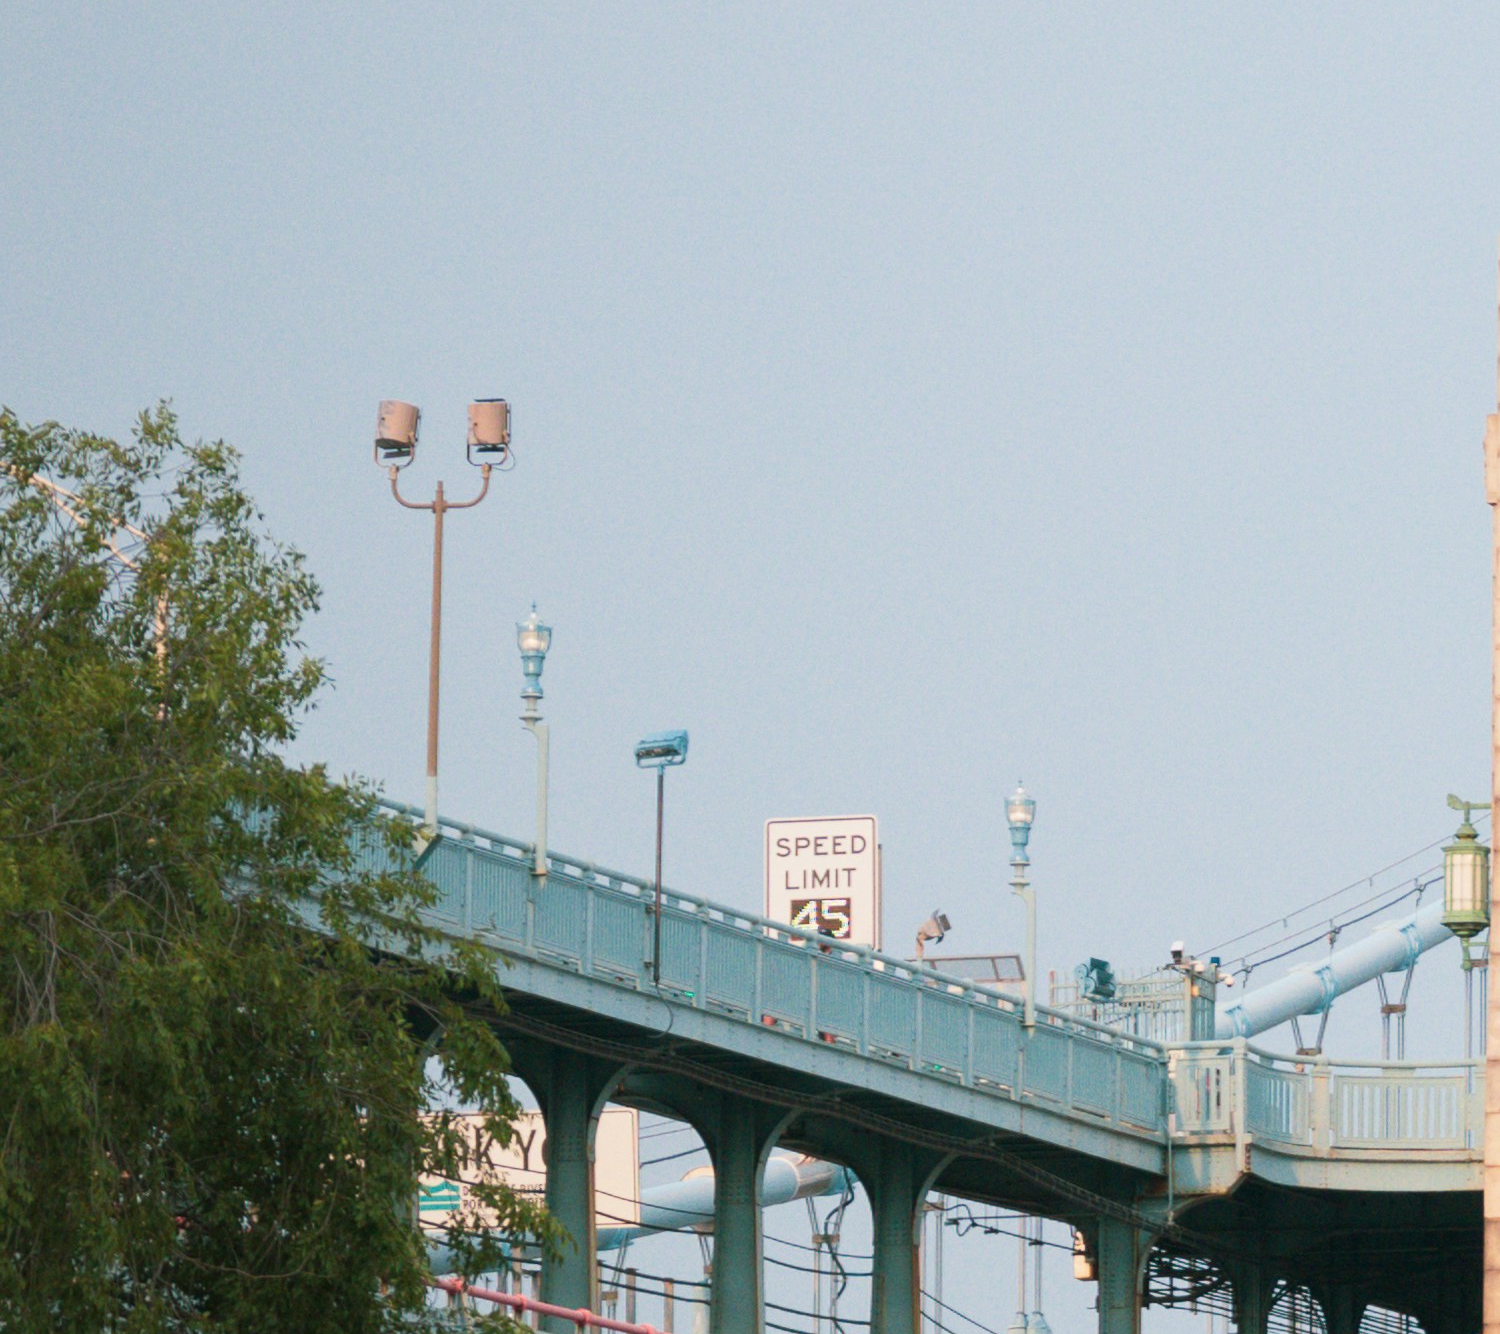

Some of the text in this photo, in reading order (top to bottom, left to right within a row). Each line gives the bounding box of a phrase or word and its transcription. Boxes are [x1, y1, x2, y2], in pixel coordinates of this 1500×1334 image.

[776, 834, 867, 857] SPEED
[785, 867, 857, 890] LIMIT
[791, 899, 850, 937] 45
